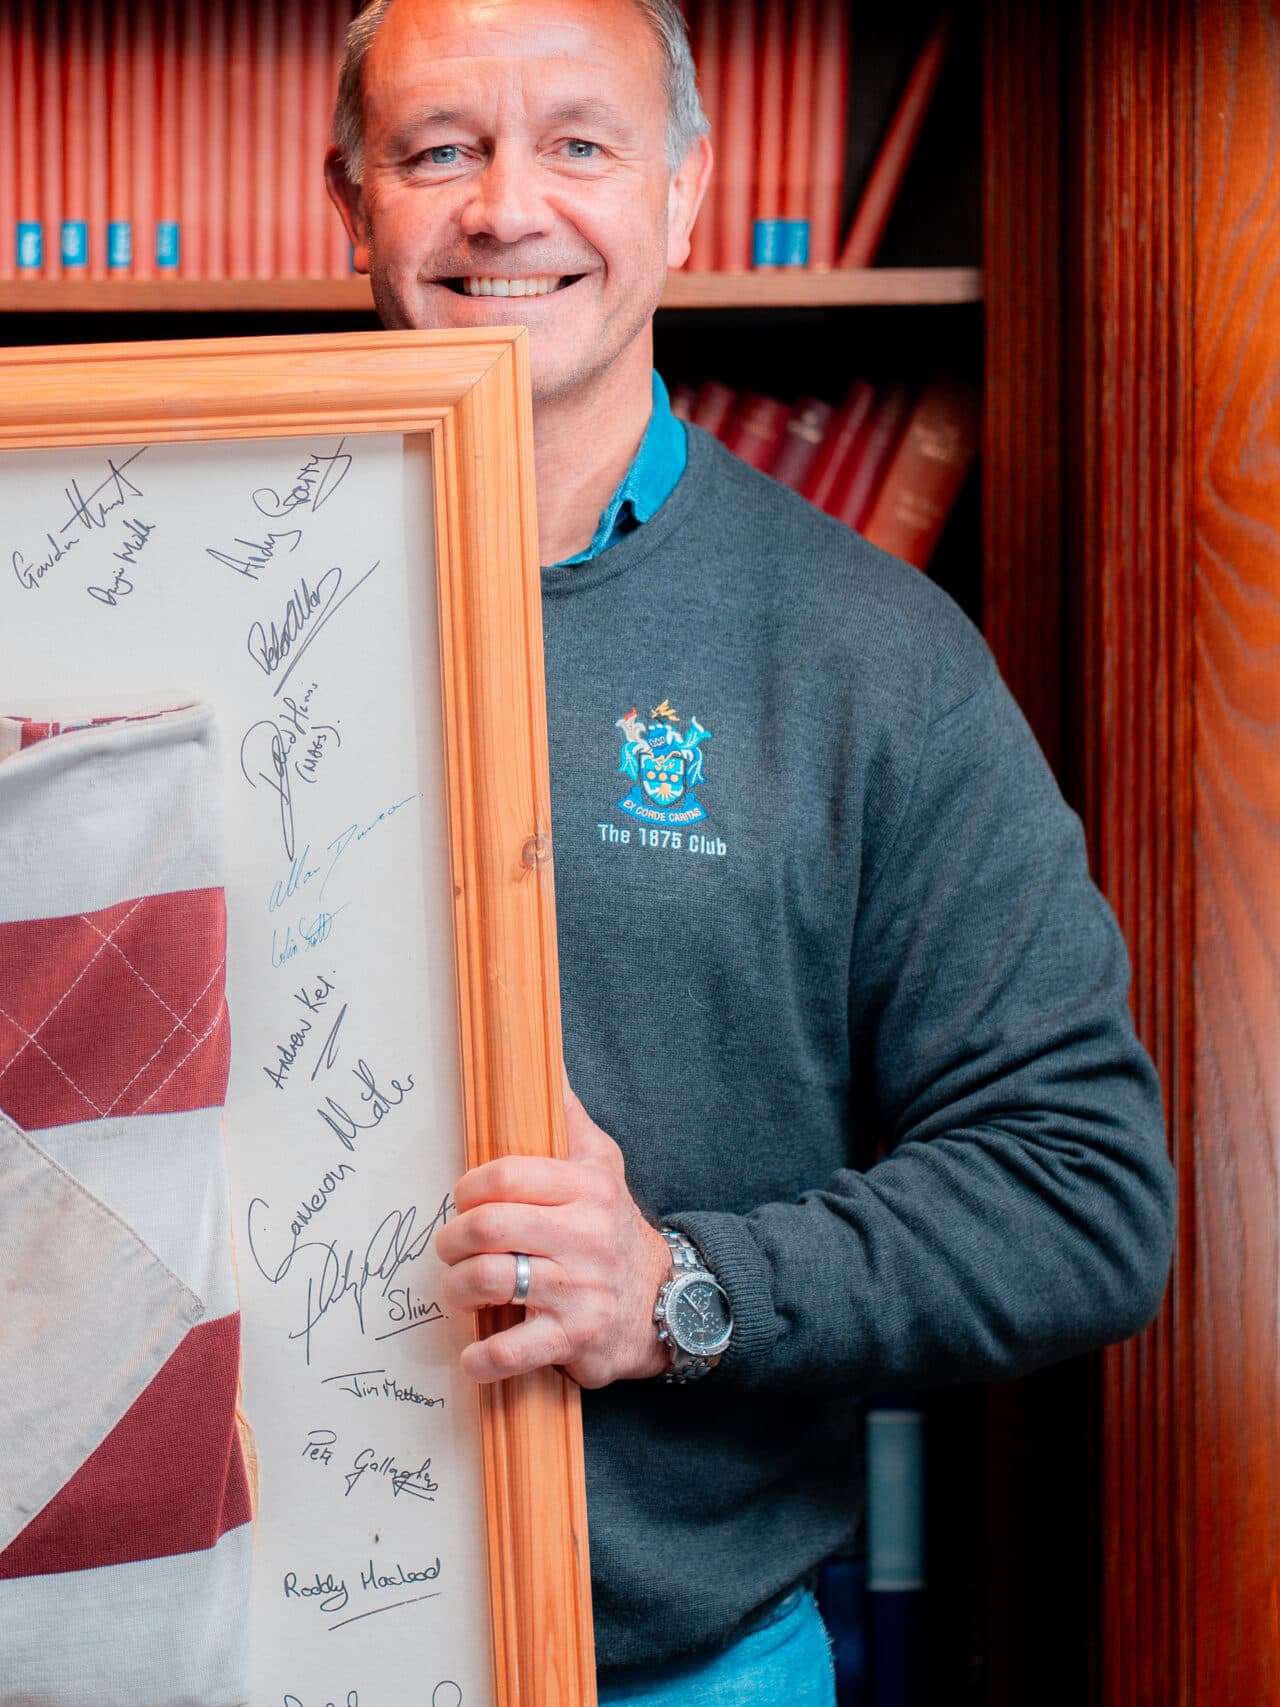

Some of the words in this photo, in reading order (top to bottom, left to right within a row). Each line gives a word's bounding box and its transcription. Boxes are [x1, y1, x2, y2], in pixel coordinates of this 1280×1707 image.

[635, 803, 666, 822] CORDE
[669, 806, 703, 824] CARITAS
[597, 823, 631, 844] The
[638, 828, 683, 850] 1875
[688, 834, 727, 857] Club
[263, 1018, 312, 1090] Andrew
[283, 1572, 349, 1612] Roddy
